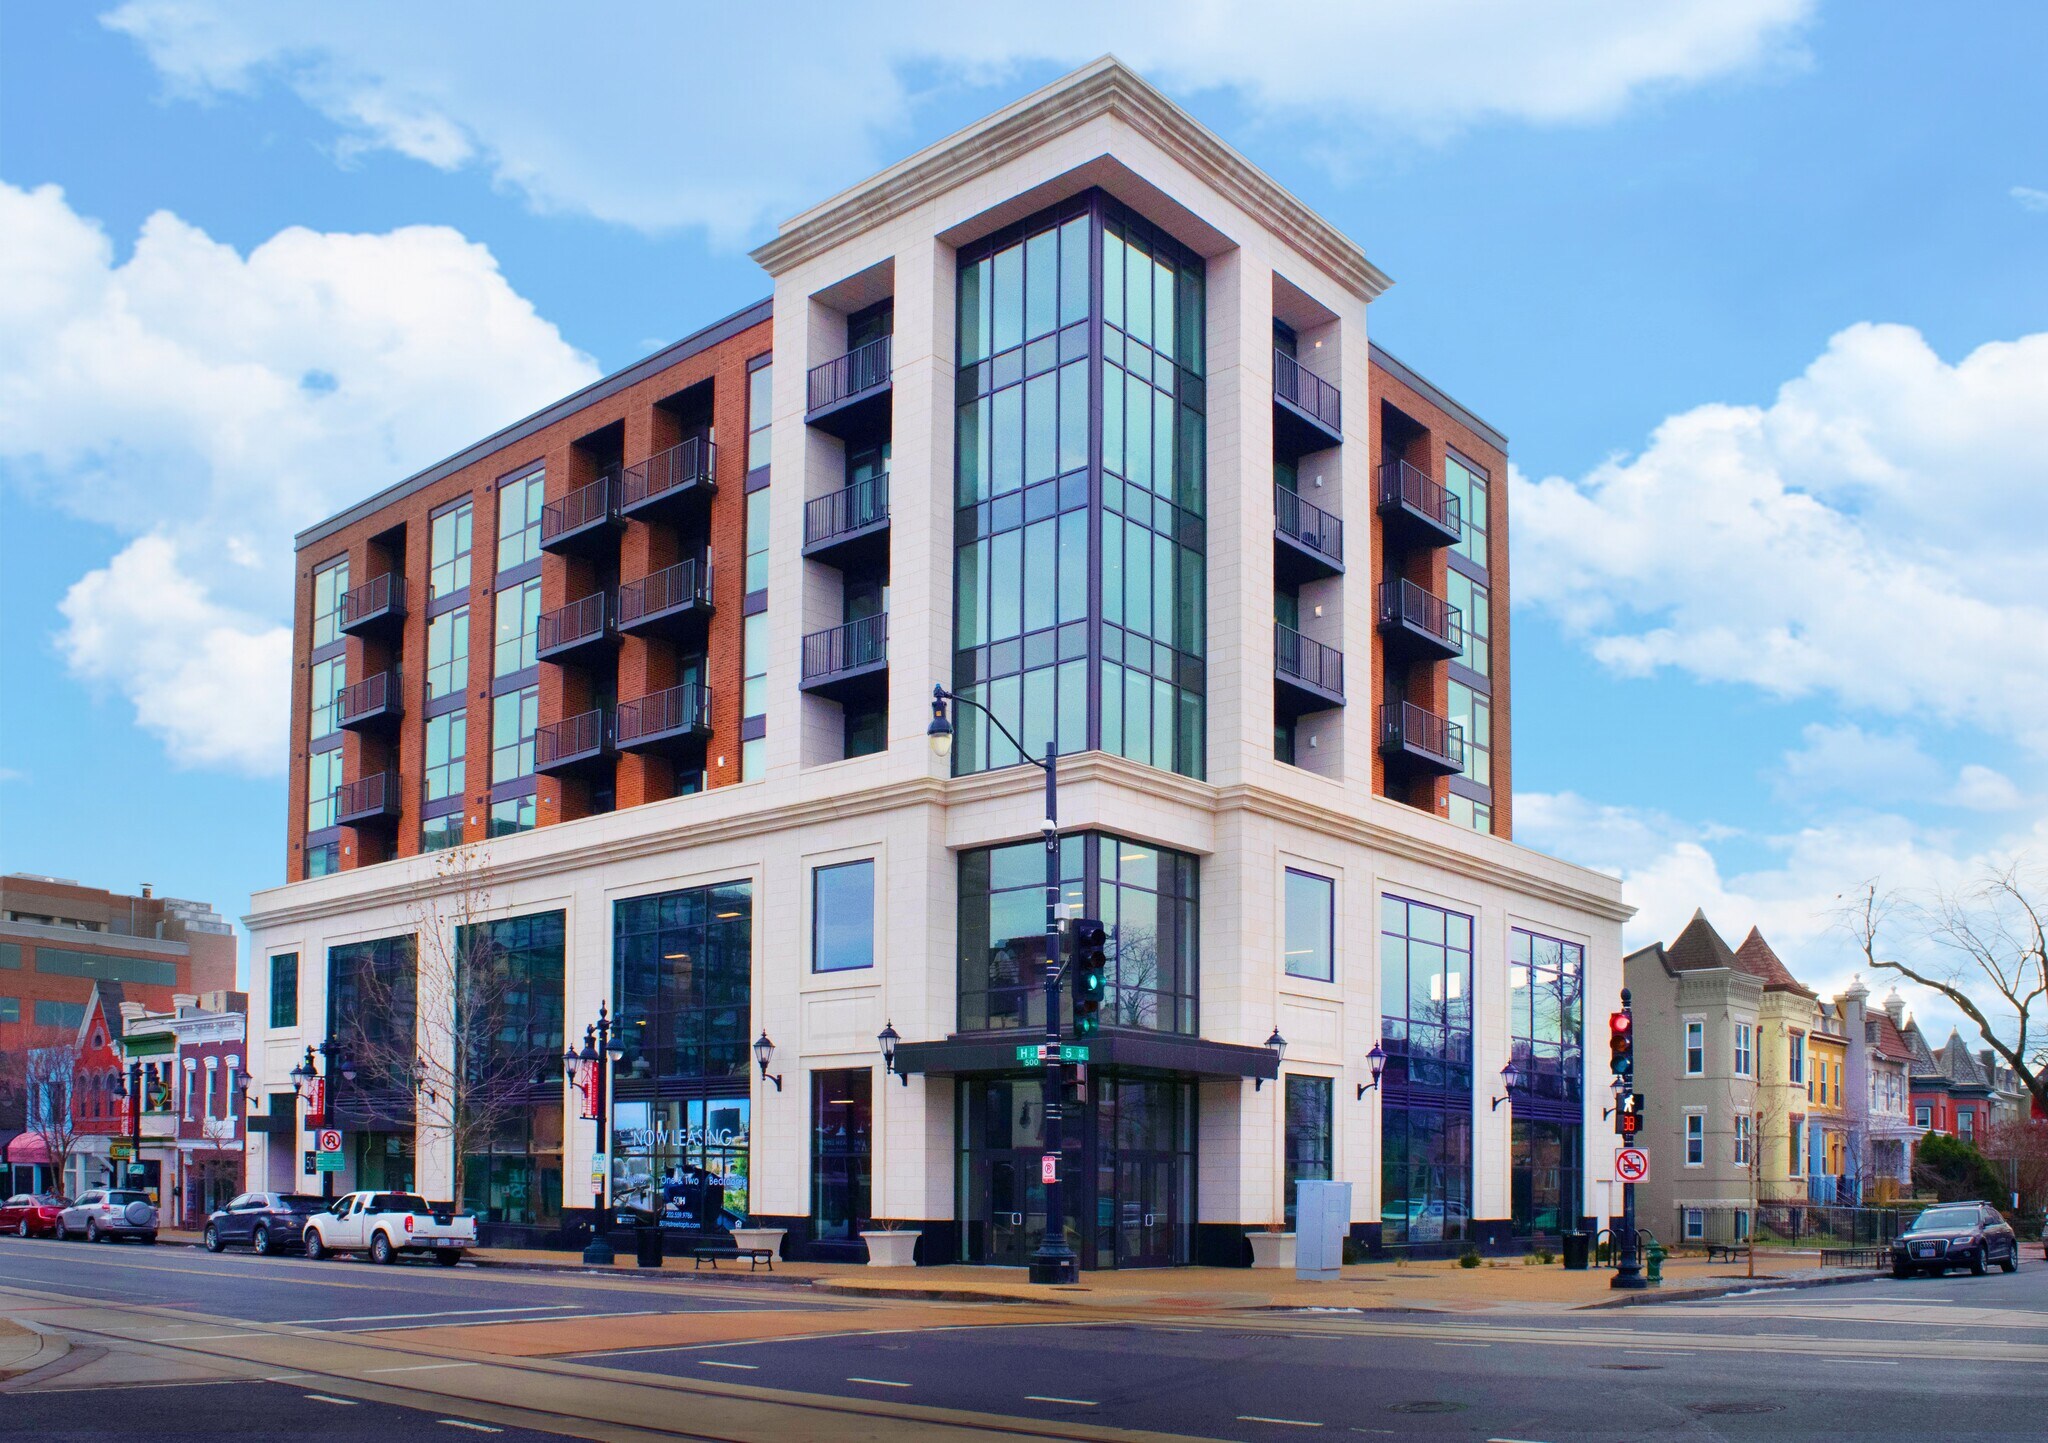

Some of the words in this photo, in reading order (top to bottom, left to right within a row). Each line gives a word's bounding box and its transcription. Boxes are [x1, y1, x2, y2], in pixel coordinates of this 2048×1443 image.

[1020, 1048, 1028, 1058] H
[1065, 1048, 1072, 1058] 5
[633, 1129, 668, 1146] NOW
[672, 1128, 732, 1147] LEASING
[685, 1176, 699, 1186] Two
